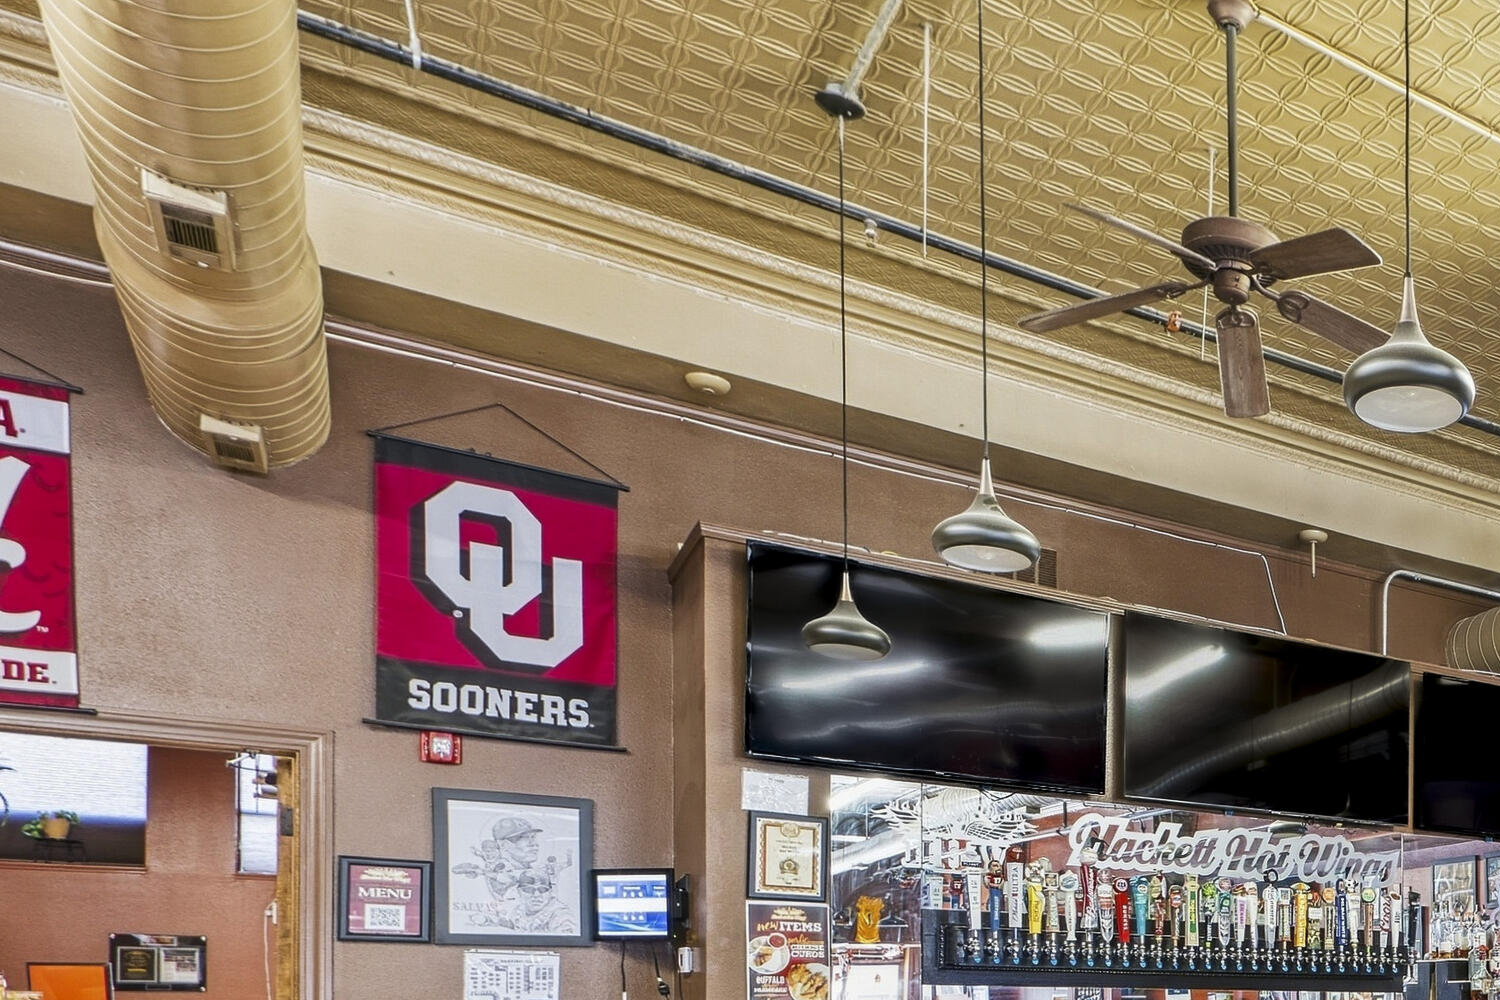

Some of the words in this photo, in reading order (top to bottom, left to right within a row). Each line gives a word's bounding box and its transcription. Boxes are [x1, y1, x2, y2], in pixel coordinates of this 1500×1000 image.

[412, 479, 583, 670] OU
[408, 678, 590, 728] SOONERS
[1069, 814, 1224, 875] Hackett
[1221, 829, 1298, 880] Hot
[1296, 837, 1400, 888] Wings
[358, 886, 413, 900] MENU
[779, 922, 822, 932] ITEMS
[756, 976, 785, 984] BUFFALO
